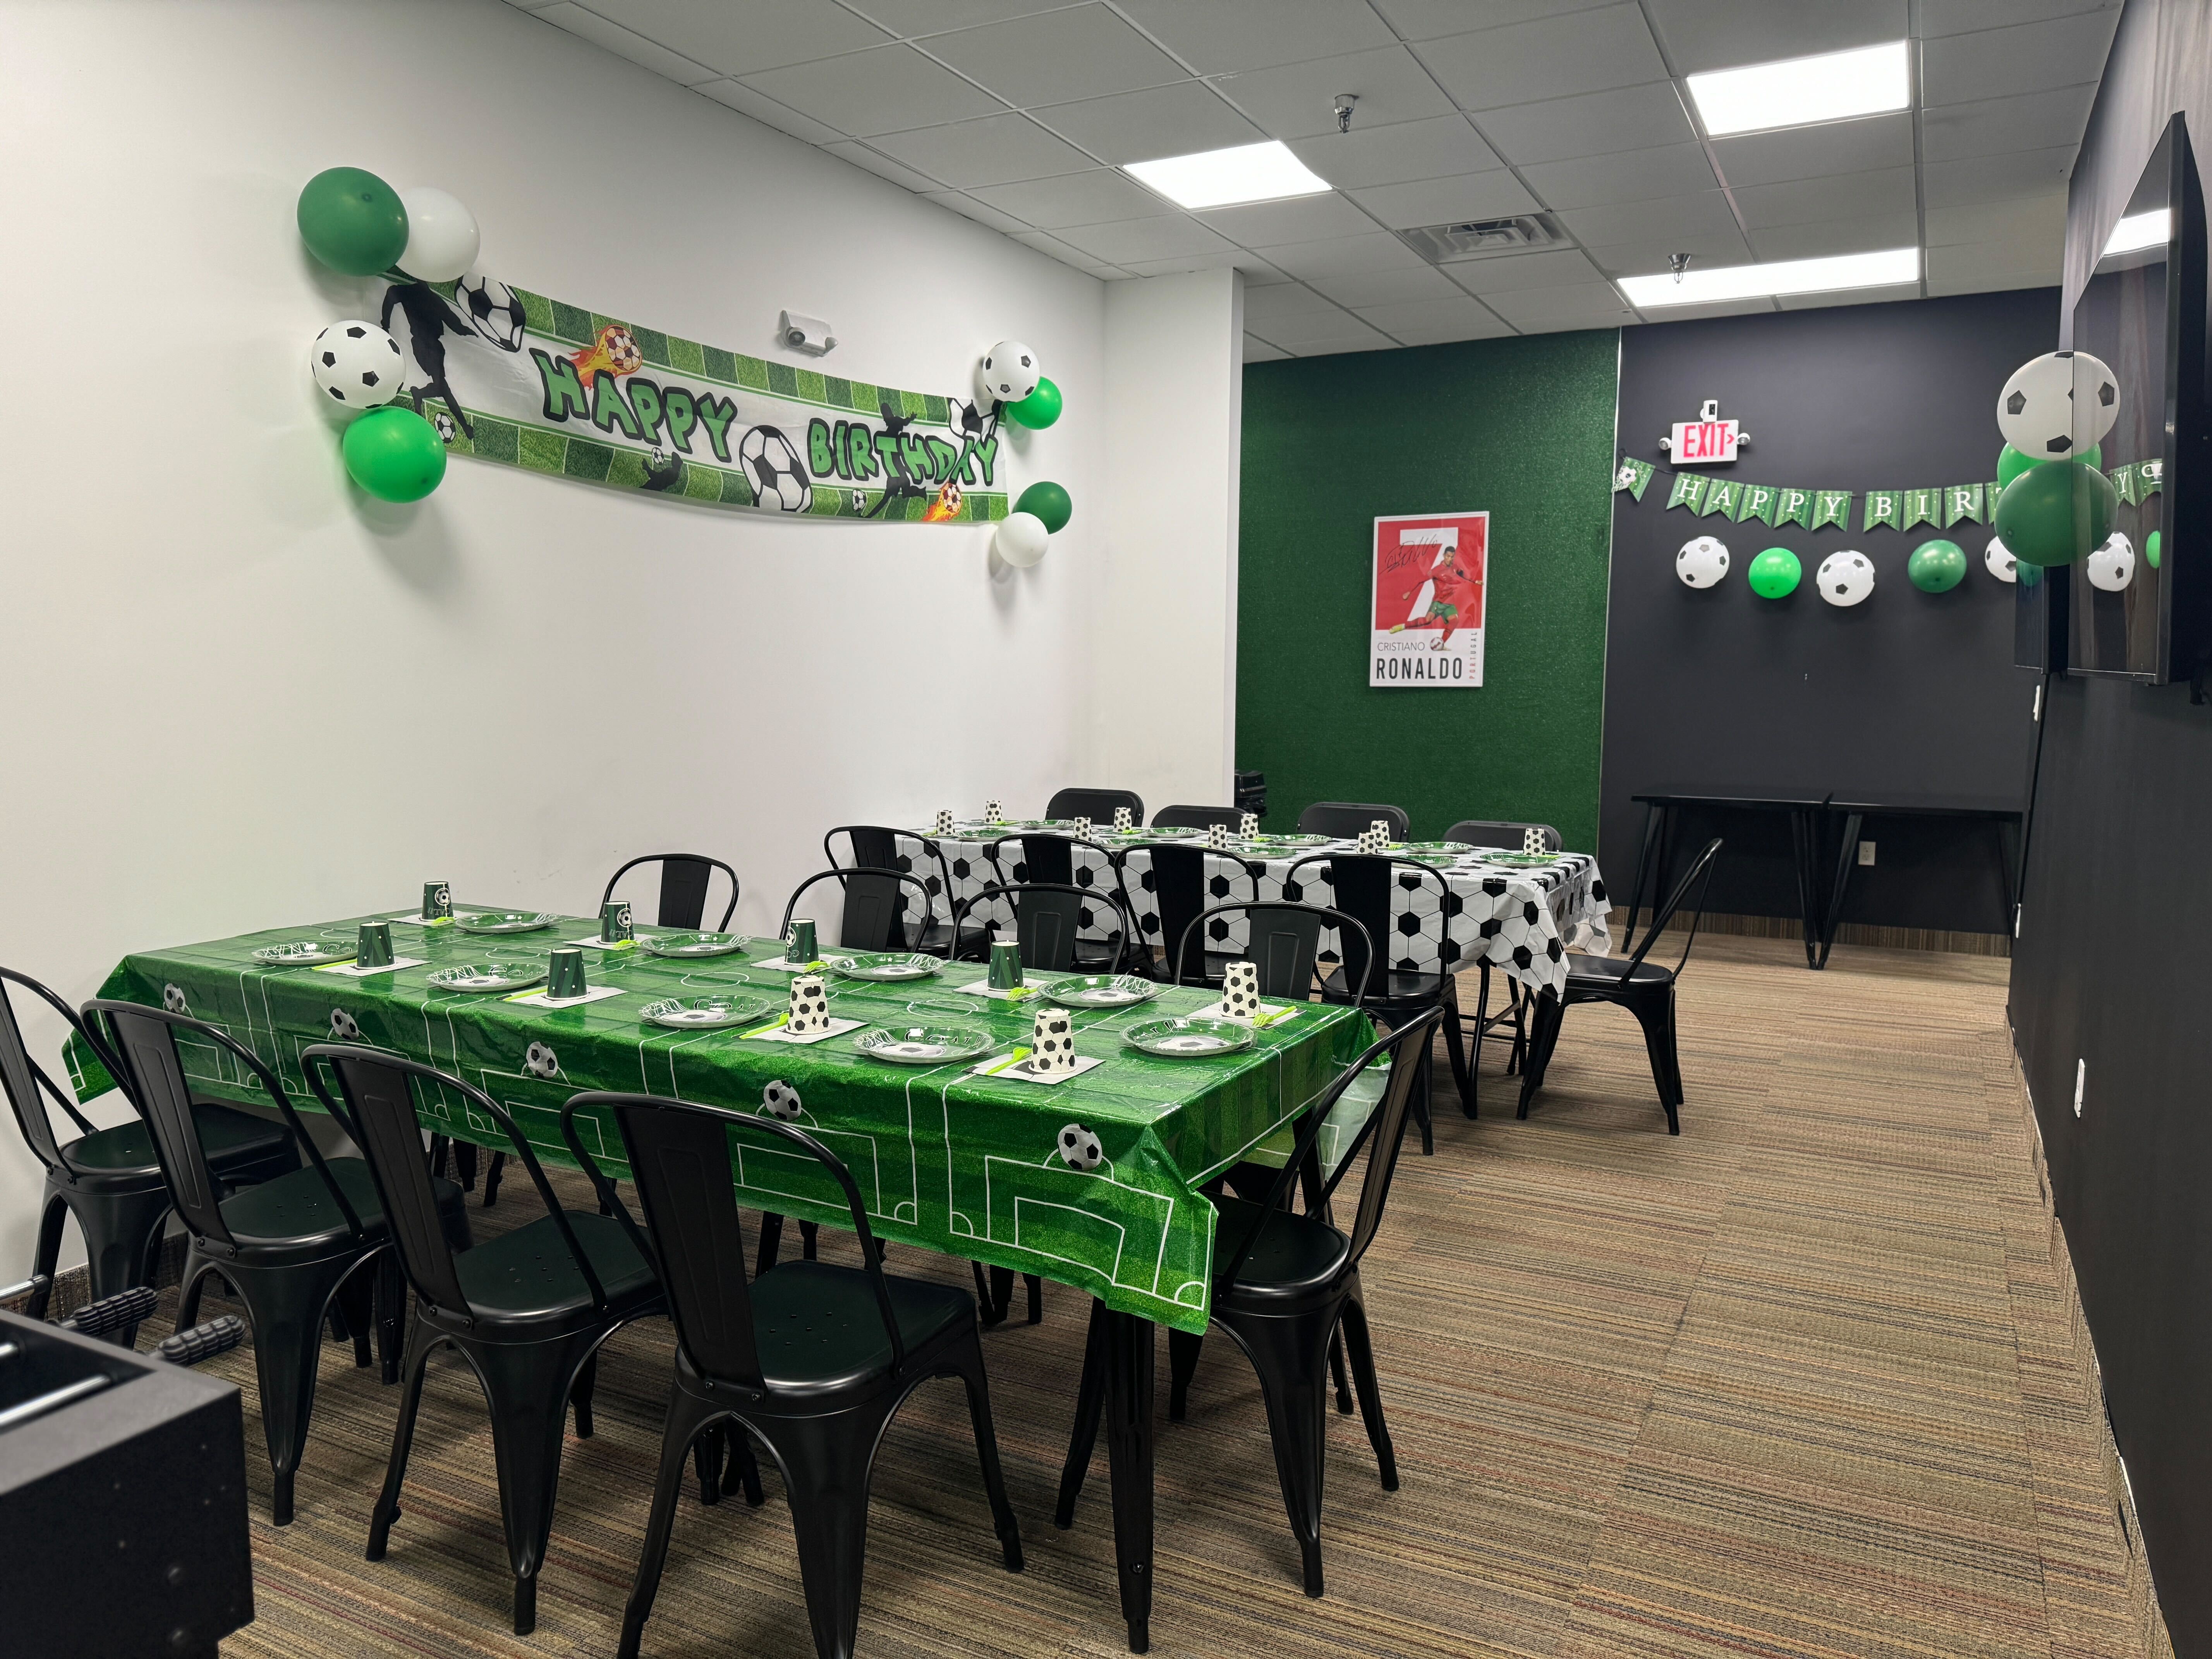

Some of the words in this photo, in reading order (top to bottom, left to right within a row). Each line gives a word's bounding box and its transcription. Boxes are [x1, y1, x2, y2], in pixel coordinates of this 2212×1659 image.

[529, 348, 737, 463] HAPPY
[807, 418, 998, 487] BIRTHDAY
[1683, 422, 1729, 458] EXIT
[1677, 479, 1844, 516] HAPPY
[1400, 527, 1458, 621] 7
[1377, 642, 1425, 651] CRISTIANO
[1376, 658, 1462, 679] RONALDO
